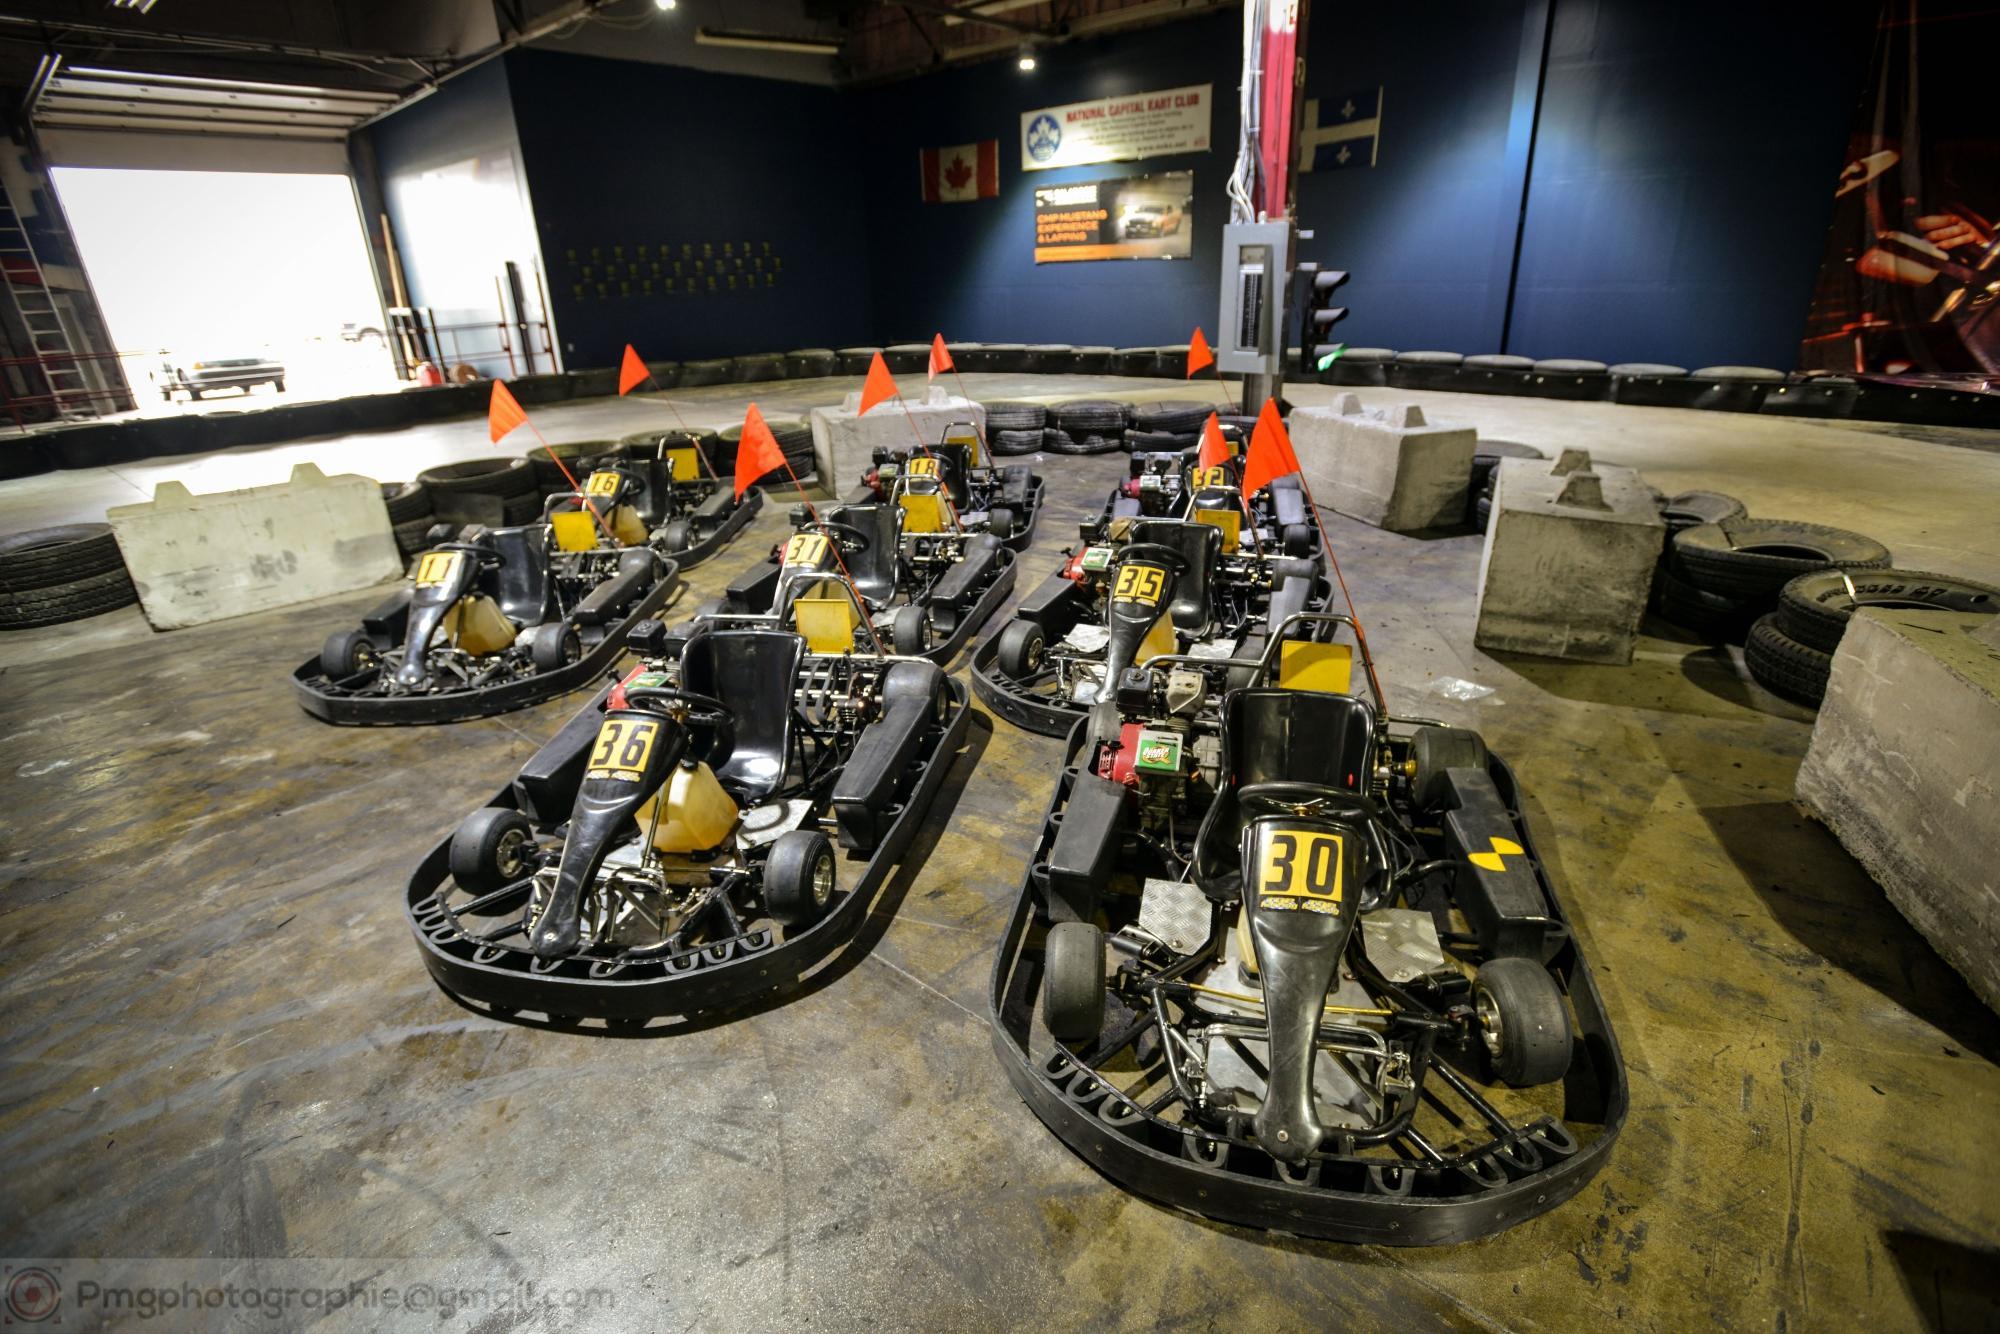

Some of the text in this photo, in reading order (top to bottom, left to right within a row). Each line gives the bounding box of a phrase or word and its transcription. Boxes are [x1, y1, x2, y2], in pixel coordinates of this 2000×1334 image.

[1066, 93, 1199, 122] NATIONAL CAPITAL KART CLUB
[914, 460, 935, 475] 18
[591, 475, 617, 491] 16
[788, 537, 822, 561] 31
[423, 556, 454, 580] 11
[1117, 568, 1162, 598] 35
[592, 723, 654, 768] 36
[1264, 834, 1339, 896] 30
